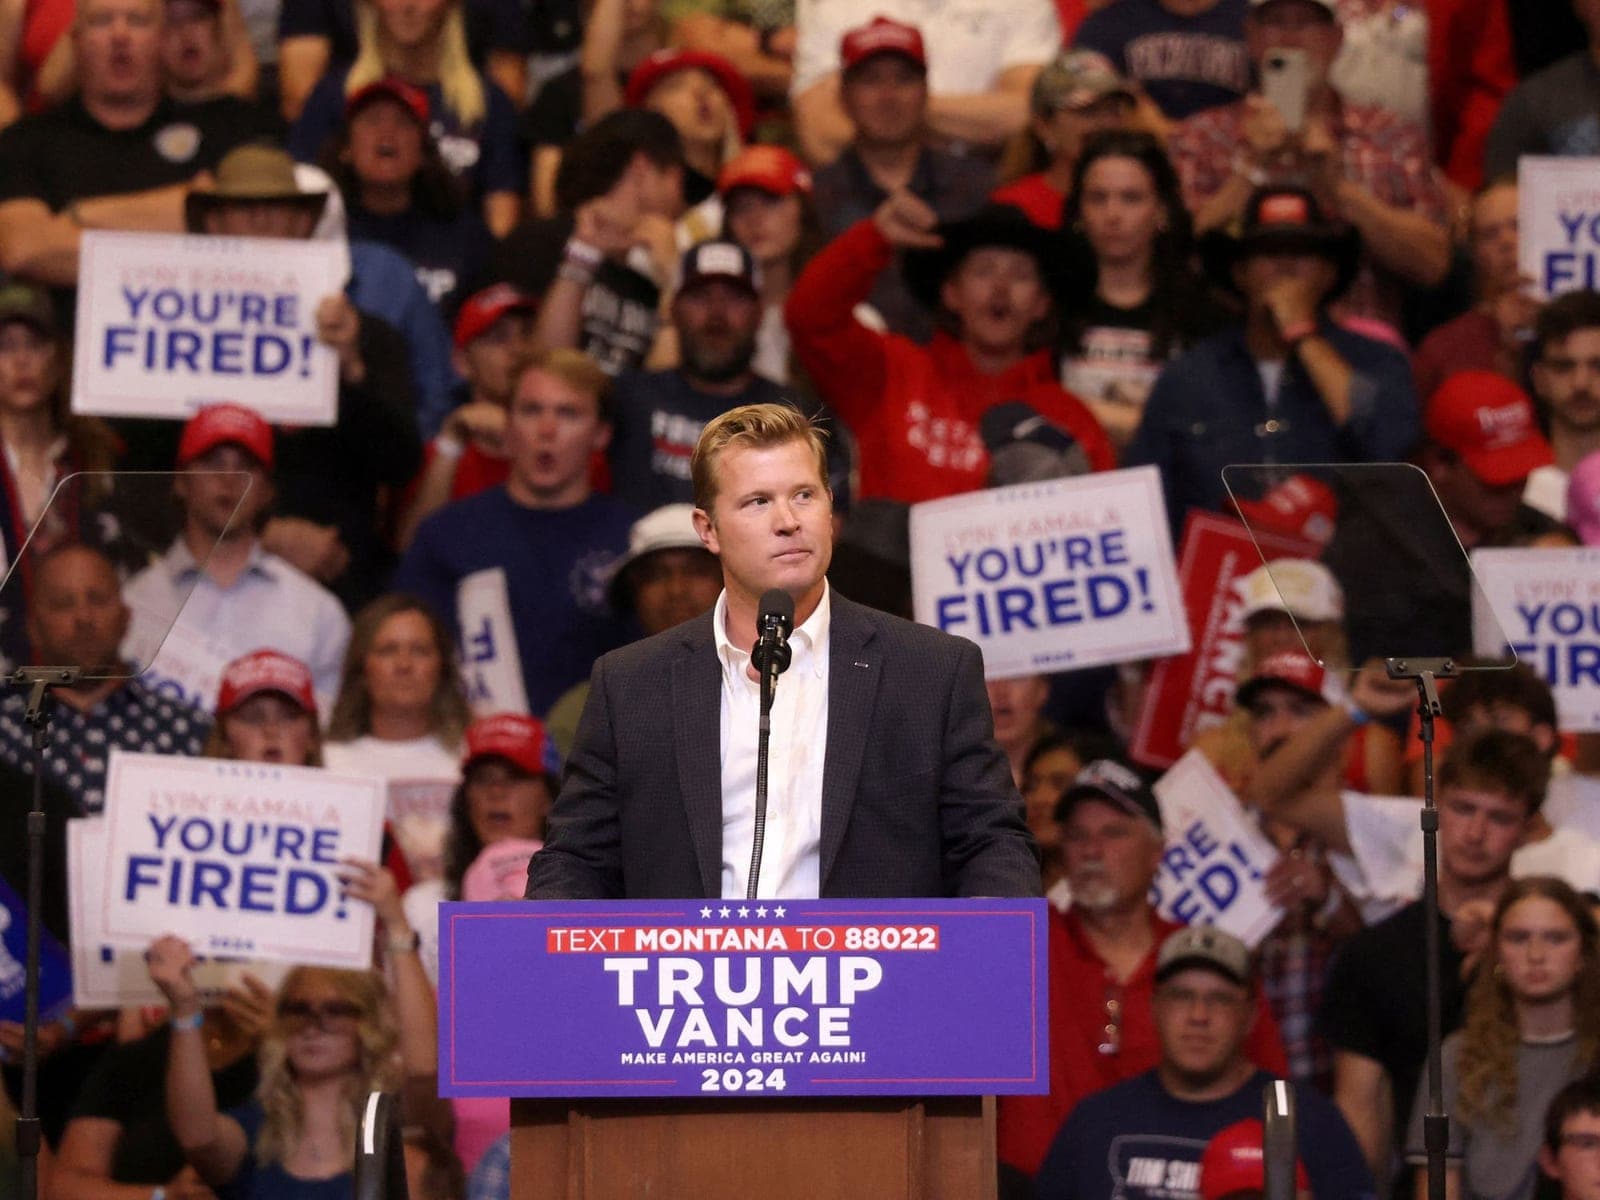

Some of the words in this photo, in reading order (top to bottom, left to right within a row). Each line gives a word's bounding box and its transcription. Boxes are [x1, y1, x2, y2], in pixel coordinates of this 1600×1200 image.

[122, 286, 298, 330] YOU'RE
[103, 326, 312, 378] FIRED!
[946, 529, 1129, 586] YOU'RE
[937, 567, 1155, 636] FIRED!
[148, 814, 340, 864] YOU'RE
[125, 855, 348, 921] FIRED!
[550, 928, 626, 953] TEXT
[634, 926, 788, 952] MONTANA
[795, 927, 837, 950] TO
[844, 926, 937, 951] 88022
[602, 955, 884, 1007] TRUMP
[634, 1005, 852, 1048] VANCE
[620, 1052, 667, 1066] MAKE
[671, 1051, 746, 1065] AMERICA
[751, 1051, 804, 1065] GREAT
[808, 1050, 867, 1065] AGAIN!
[700, 1068, 788, 1092] 2024
